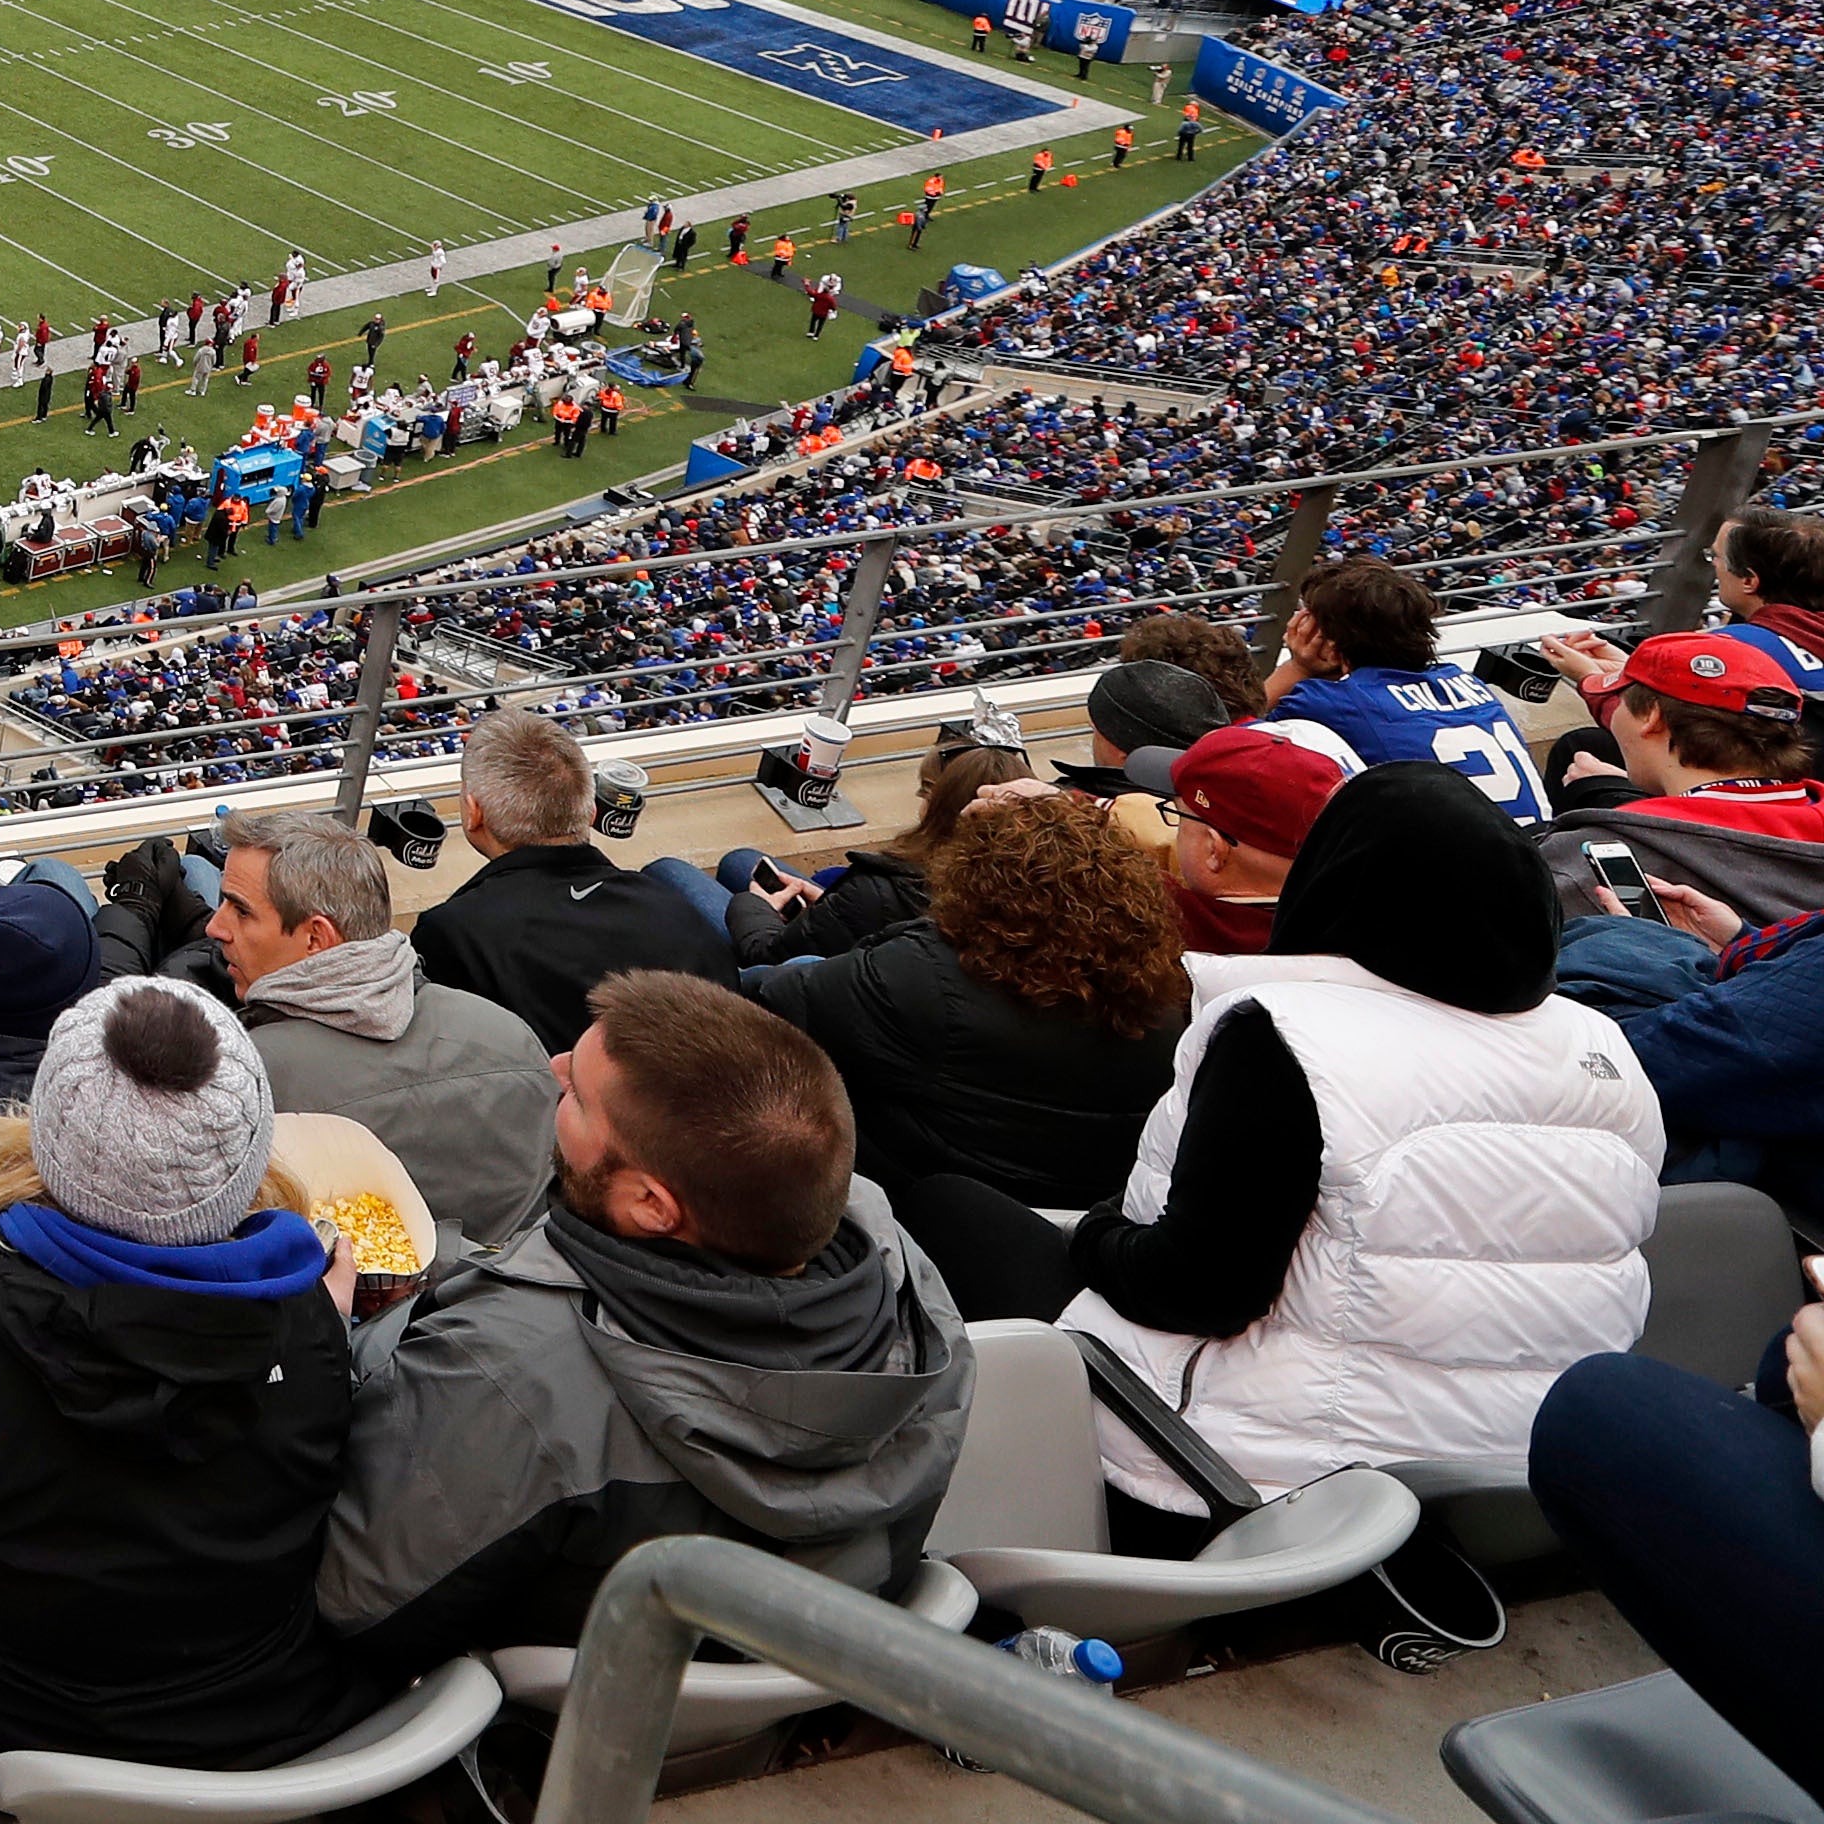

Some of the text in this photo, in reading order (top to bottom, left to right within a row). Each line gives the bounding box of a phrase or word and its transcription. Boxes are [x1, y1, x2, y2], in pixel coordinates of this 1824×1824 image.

[1081, 25, 1103, 40] NFL
[477, 61, 552, 85] 10
[316, 89, 397, 116] 20
[148, 121, 224, 151] 30
[1431, 721, 1552, 822] 21
